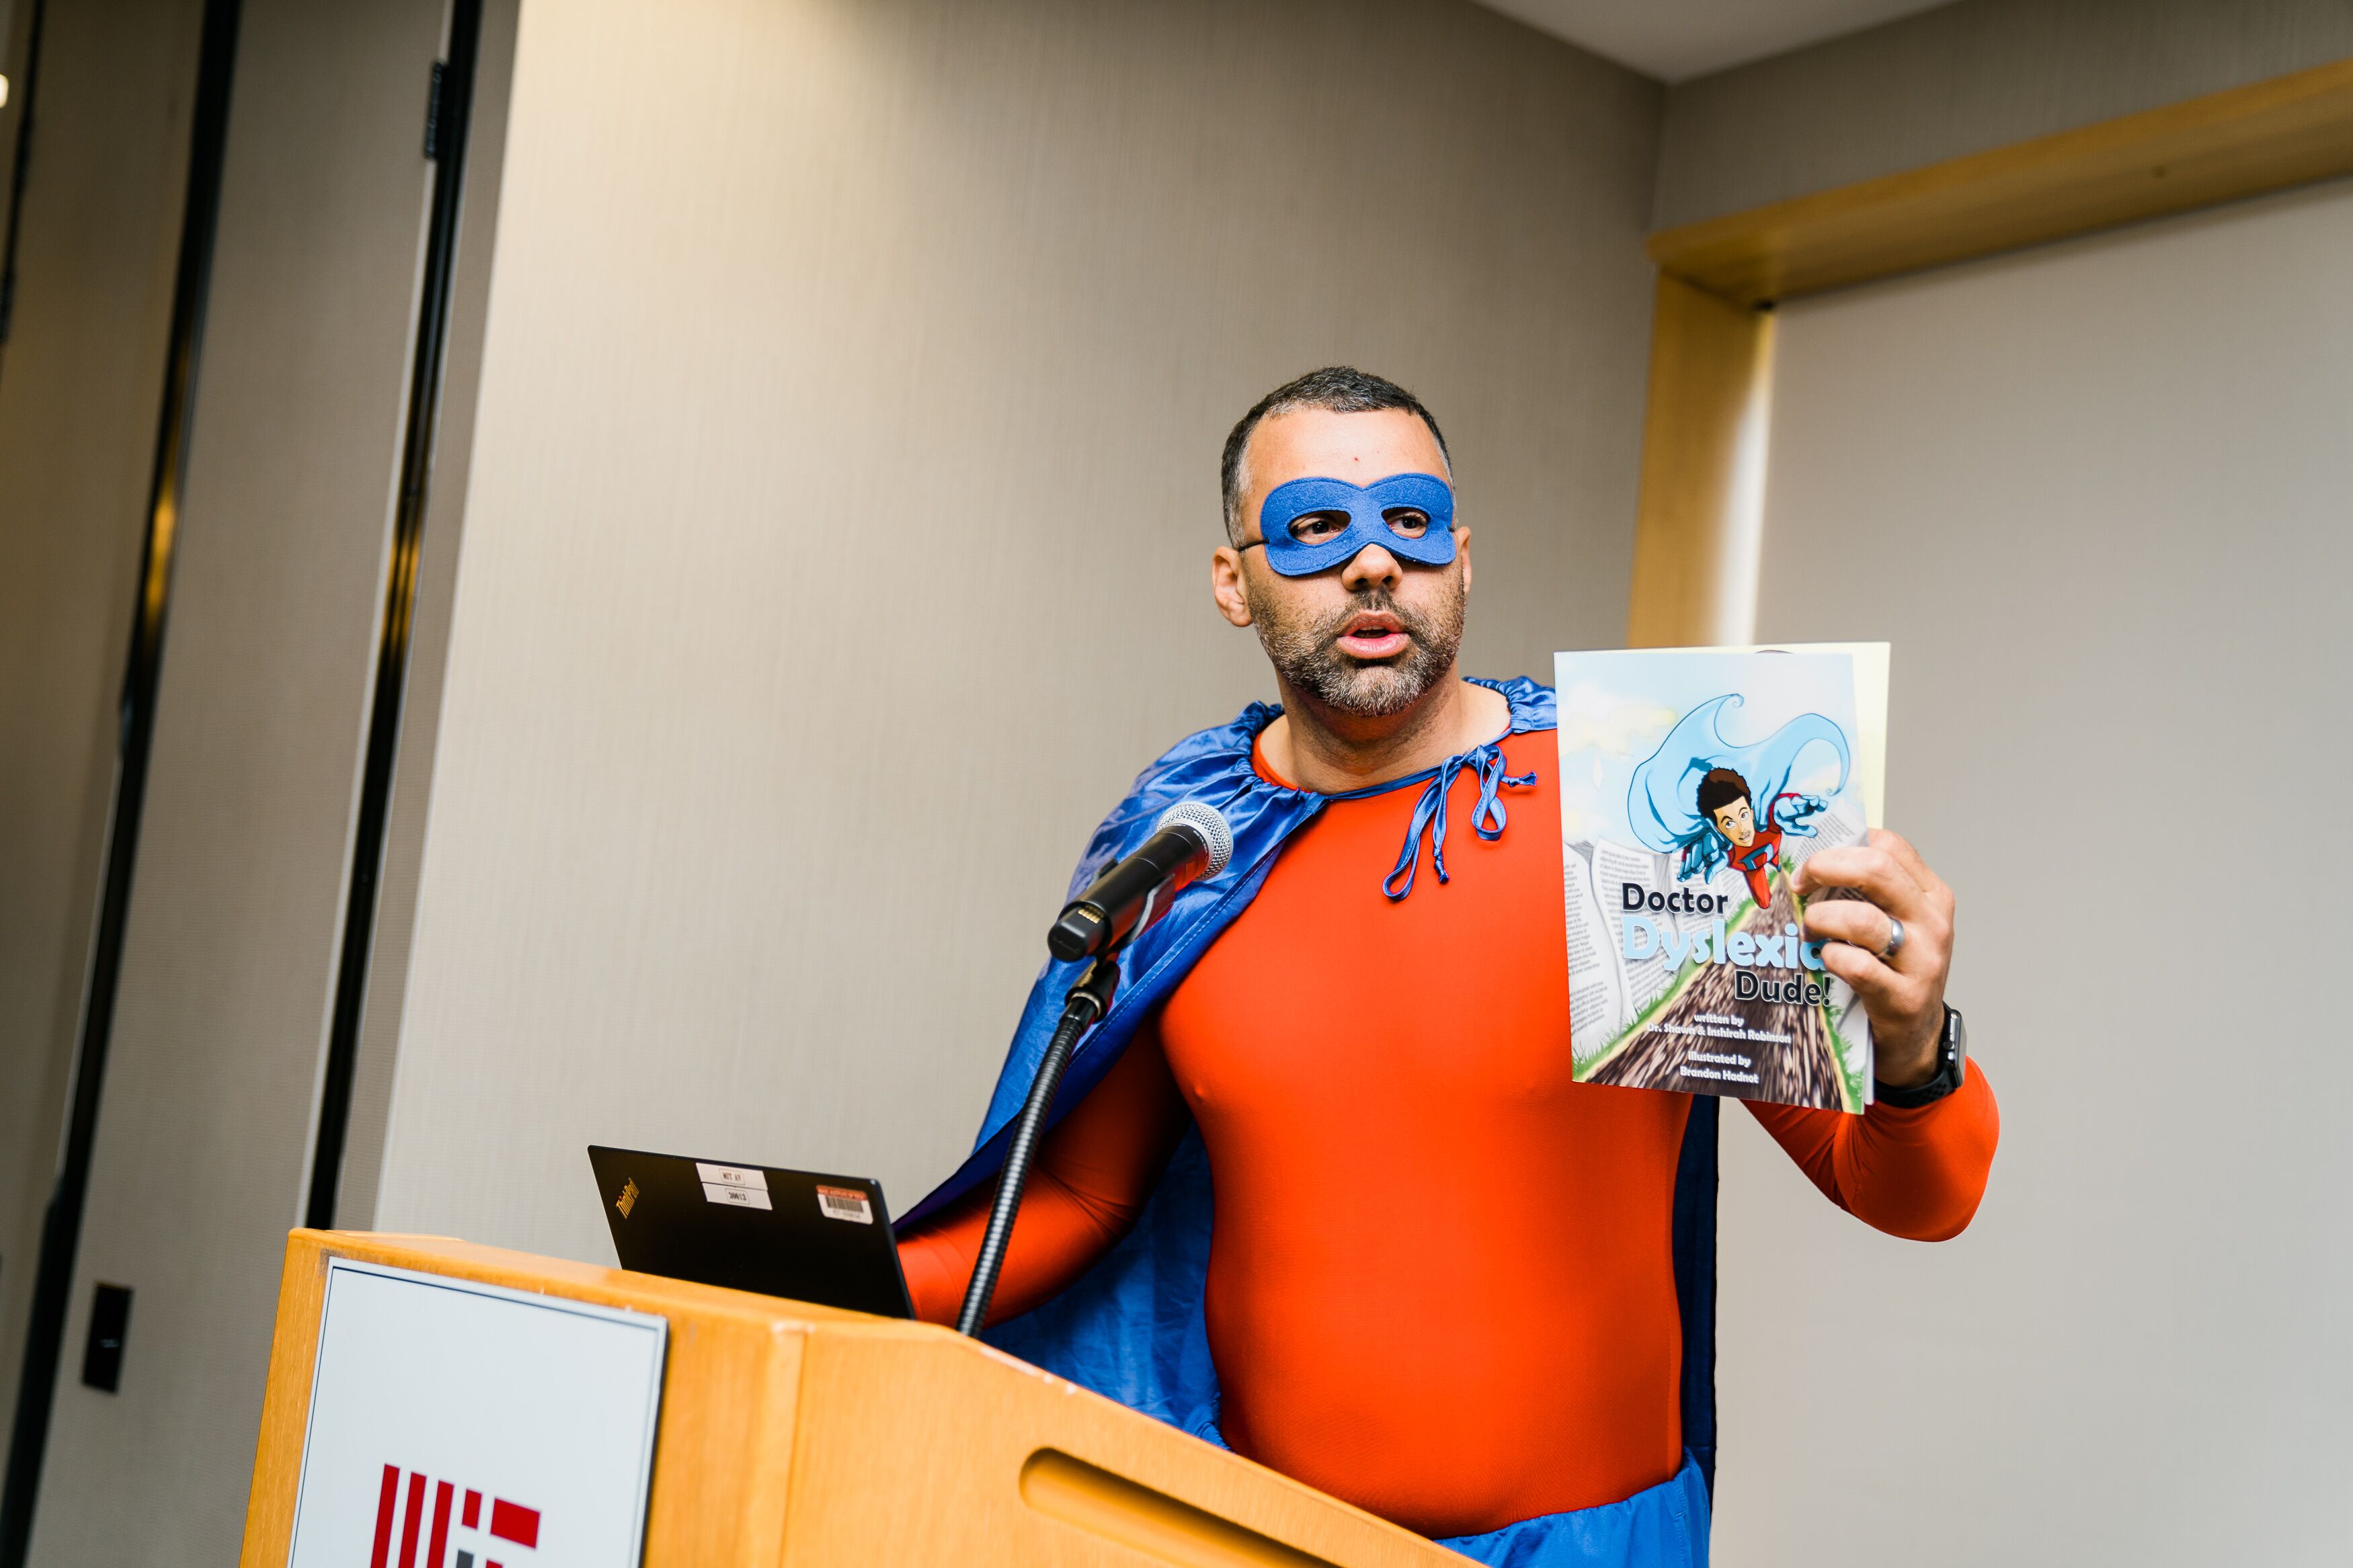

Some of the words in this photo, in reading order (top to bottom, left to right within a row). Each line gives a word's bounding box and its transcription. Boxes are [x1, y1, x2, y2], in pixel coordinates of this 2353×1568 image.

[1193, 829, 1203, 843] BETA
[1622, 882, 1728, 914] Doctor
[1734, 970, 1831, 1007] Dude!
[1694, 1014, 1729, 1025] written
[1730, 1015, 1744, 1027] by
[1647, 1023, 1662, 1032] Dr.
[1664, 1024, 1696, 1035] Shawn
[1698, 1026, 1706, 1036] &
[1707, 1026, 1747, 1040] Inshirah
[1747, 1029, 1792, 1044] Robinson
[1688, 1050, 1737, 1064] illustrated
[1738, 1055, 1751, 1068] by
[1680, 1066, 1721, 1079] Brandon
[1722, 1070, 1759, 1084] Hadnot
[616, 1177, 639, 1219] ThinkPad
